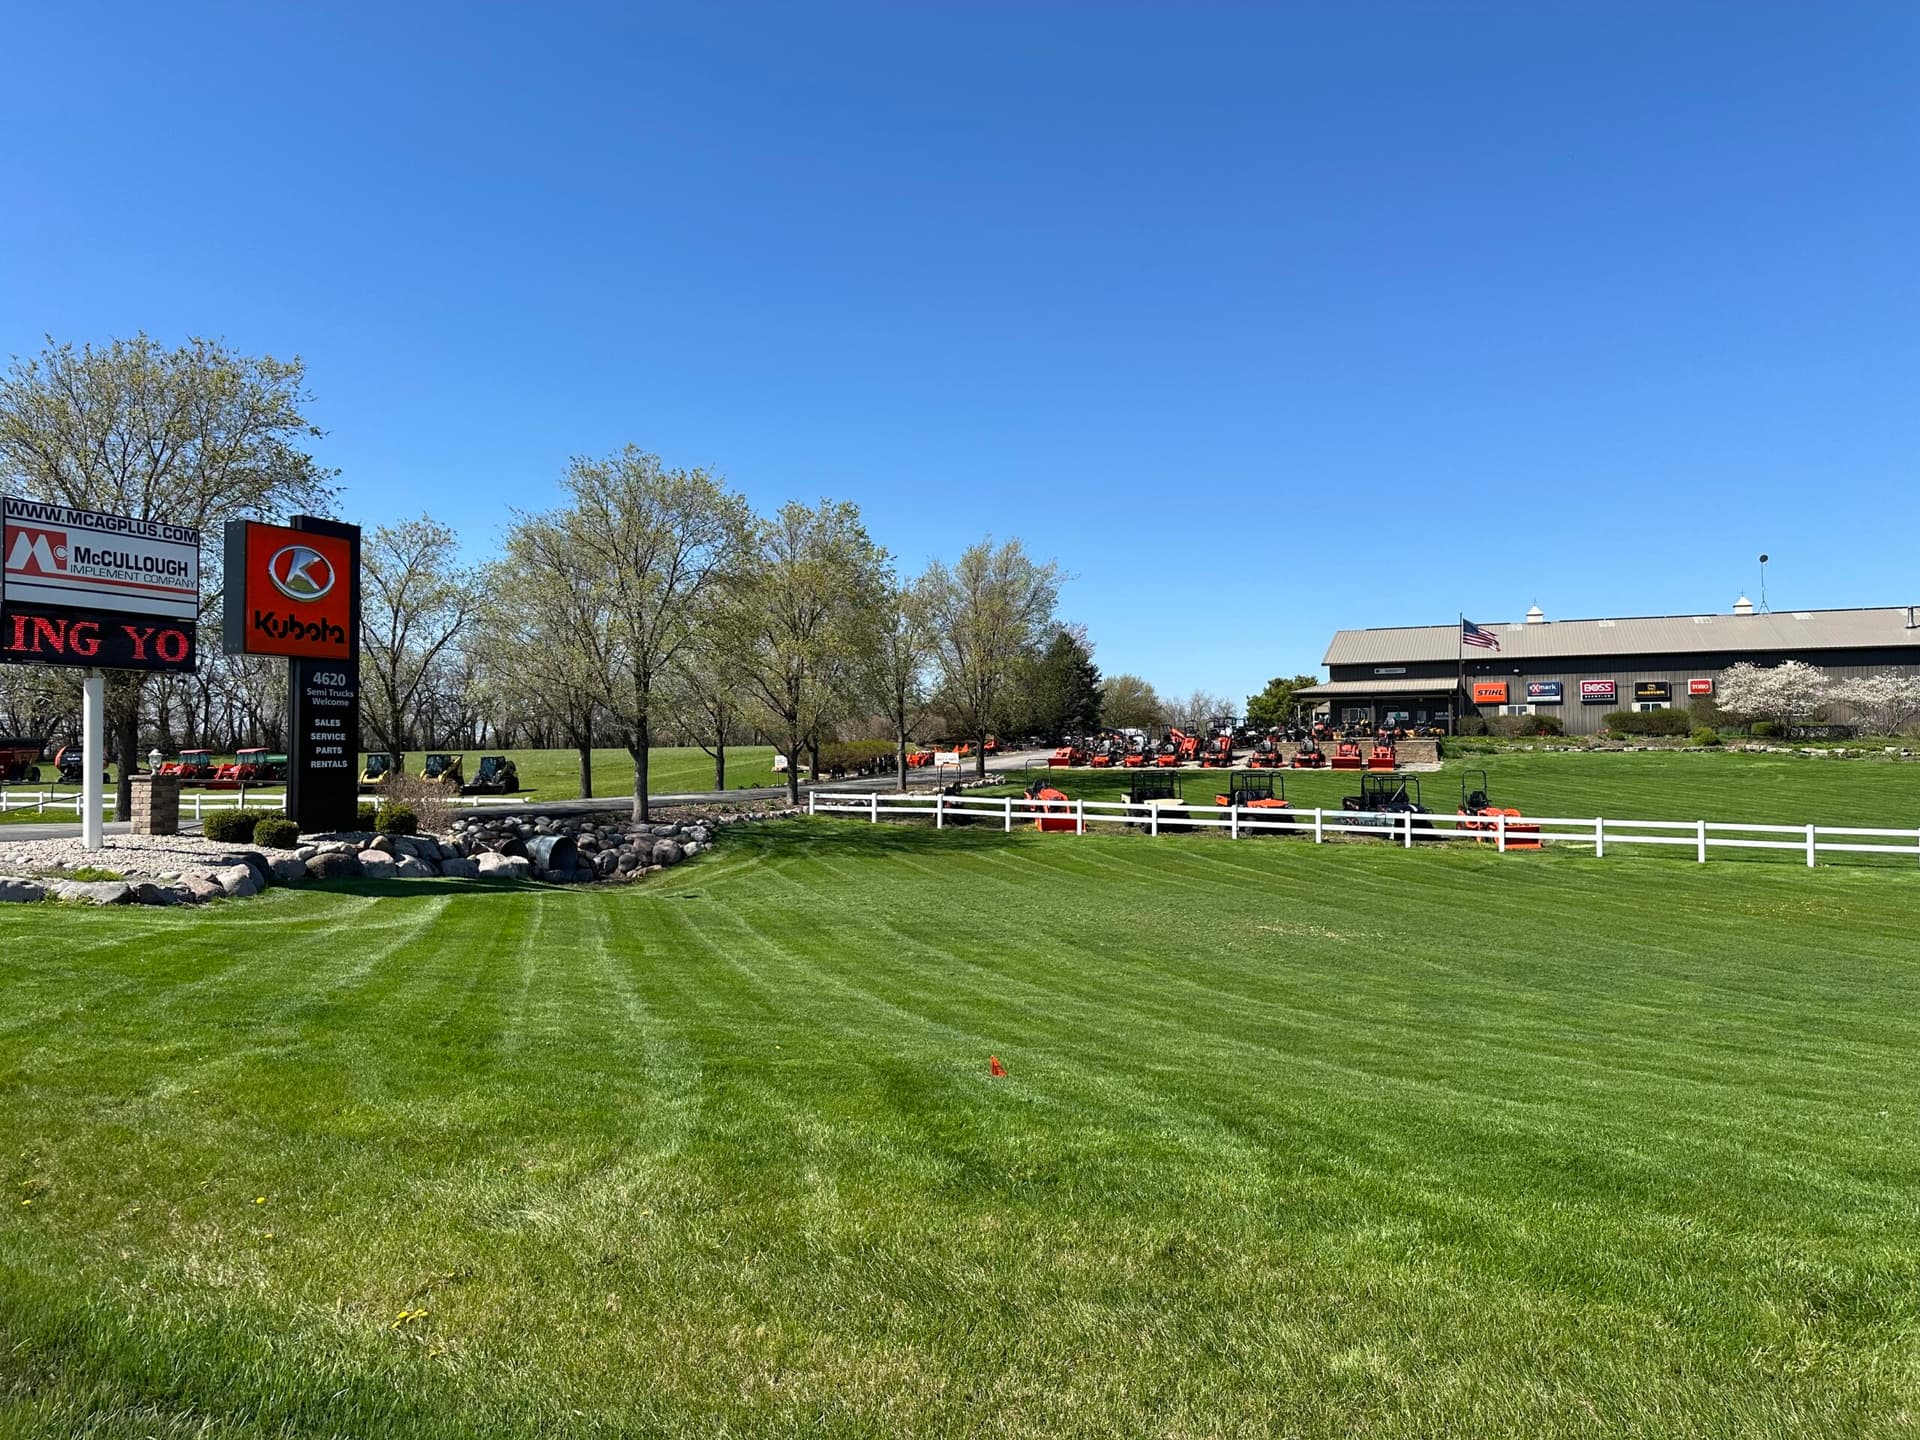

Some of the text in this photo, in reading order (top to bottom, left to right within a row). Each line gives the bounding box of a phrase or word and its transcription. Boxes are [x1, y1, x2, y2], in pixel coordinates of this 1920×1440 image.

[6, 501, 197, 543] WWW.MCAGPLUS.COM
[70, 564, 196, 588] IMPLEMENT COMPANY
[255, 609, 345, 644] Kubota
[121, 625, 189, 663] YO
[313, 671, 346, 687] 4620
[1584, 683, 1612, 692] BOSS
[306, 687, 354, 698] Semi Trucks
[1477, 689, 1504, 697] STIHL
[312, 697, 349, 706] Welcome
[314, 718, 341, 727] SALES
[310, 732, 346, 741] SERVICE
[315, 746, 343, 755] PARTS
[310, 760, 348, 768] RENTALS
